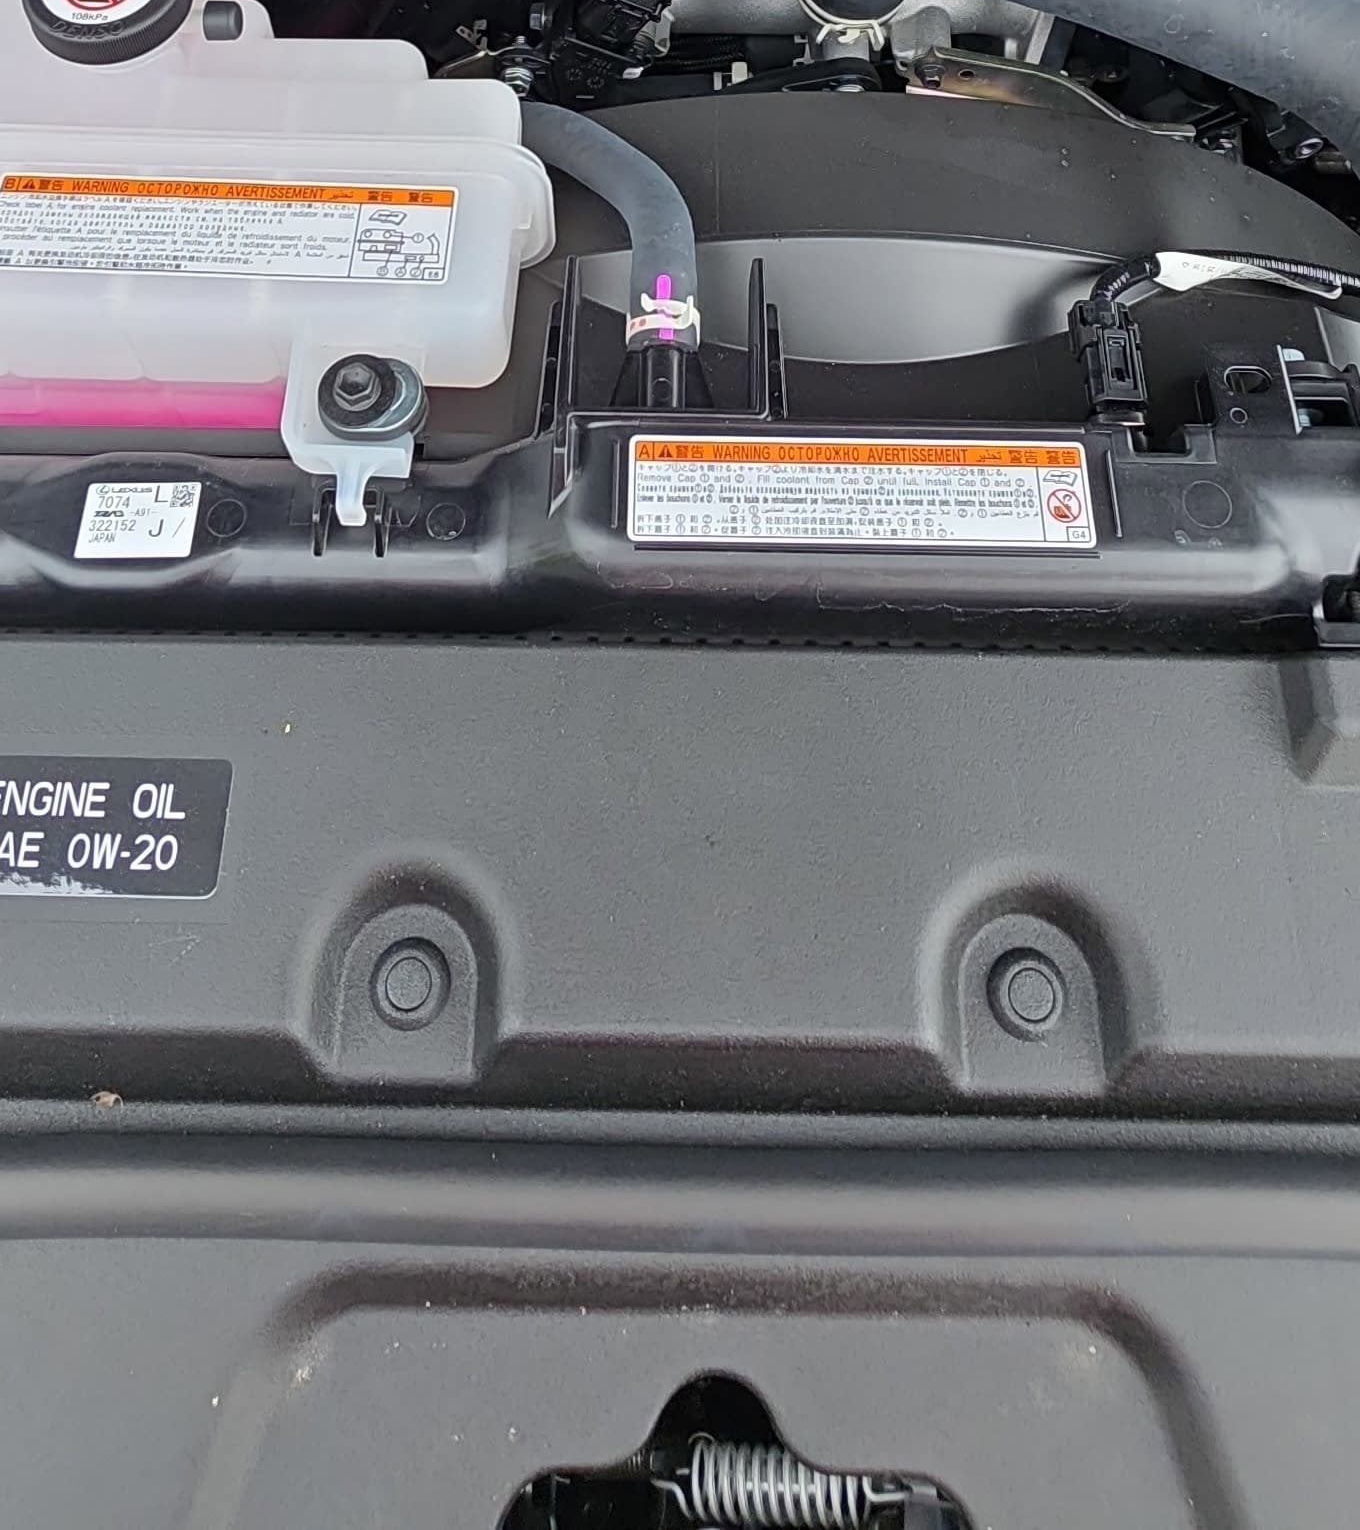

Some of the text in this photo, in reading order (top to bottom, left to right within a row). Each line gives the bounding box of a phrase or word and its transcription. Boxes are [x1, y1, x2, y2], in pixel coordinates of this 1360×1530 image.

[71, 12, 109, 21] 108kPa
[49, 21, 125, 40] DENSO
[4, 178, 17, 190] B
[72, 180, 129, 193] WARNING
[137, 181, 219, 197] ОСТОРОЖНО
[226, 184, 325, 201] AVERTISSEMENT
[638, 445, 650, 458] A
[676, 445, 705, 459] 警告
[712, 446, 771, 461] WARNING
[778, 446, 860, 462] ОСТОРОЖНО
[868, 447, 968, 464] AVERTISSEMENT
[636, 471, 671, 483] Remove
[676, 472, 695, 483] Cap
[713, 473, 731, 483] and
[757, 473, 769, 484] Fill
[775, 473, 809, 485] coolant
[815, 474, 835, 485] from
[840, 474, 859, 485] Cap
[876, 475, 897, 486] until
[924, 476, 952, 487] Install
[956, 476, 976, 487] Cap
[993, 477, 1011, 488] and
[154, 485, 168, 503] L
[98, 496, 131, 509] 7074
[88, 519, 137, 532] 322152
[148, 519, 164, 538] J
[88, 533, 116, 543] JAPAN
[1071, 530, 1086, 539] G4
[132, 783, 186, 820] OIL
[67, 833, 179, 871] 0W-20
